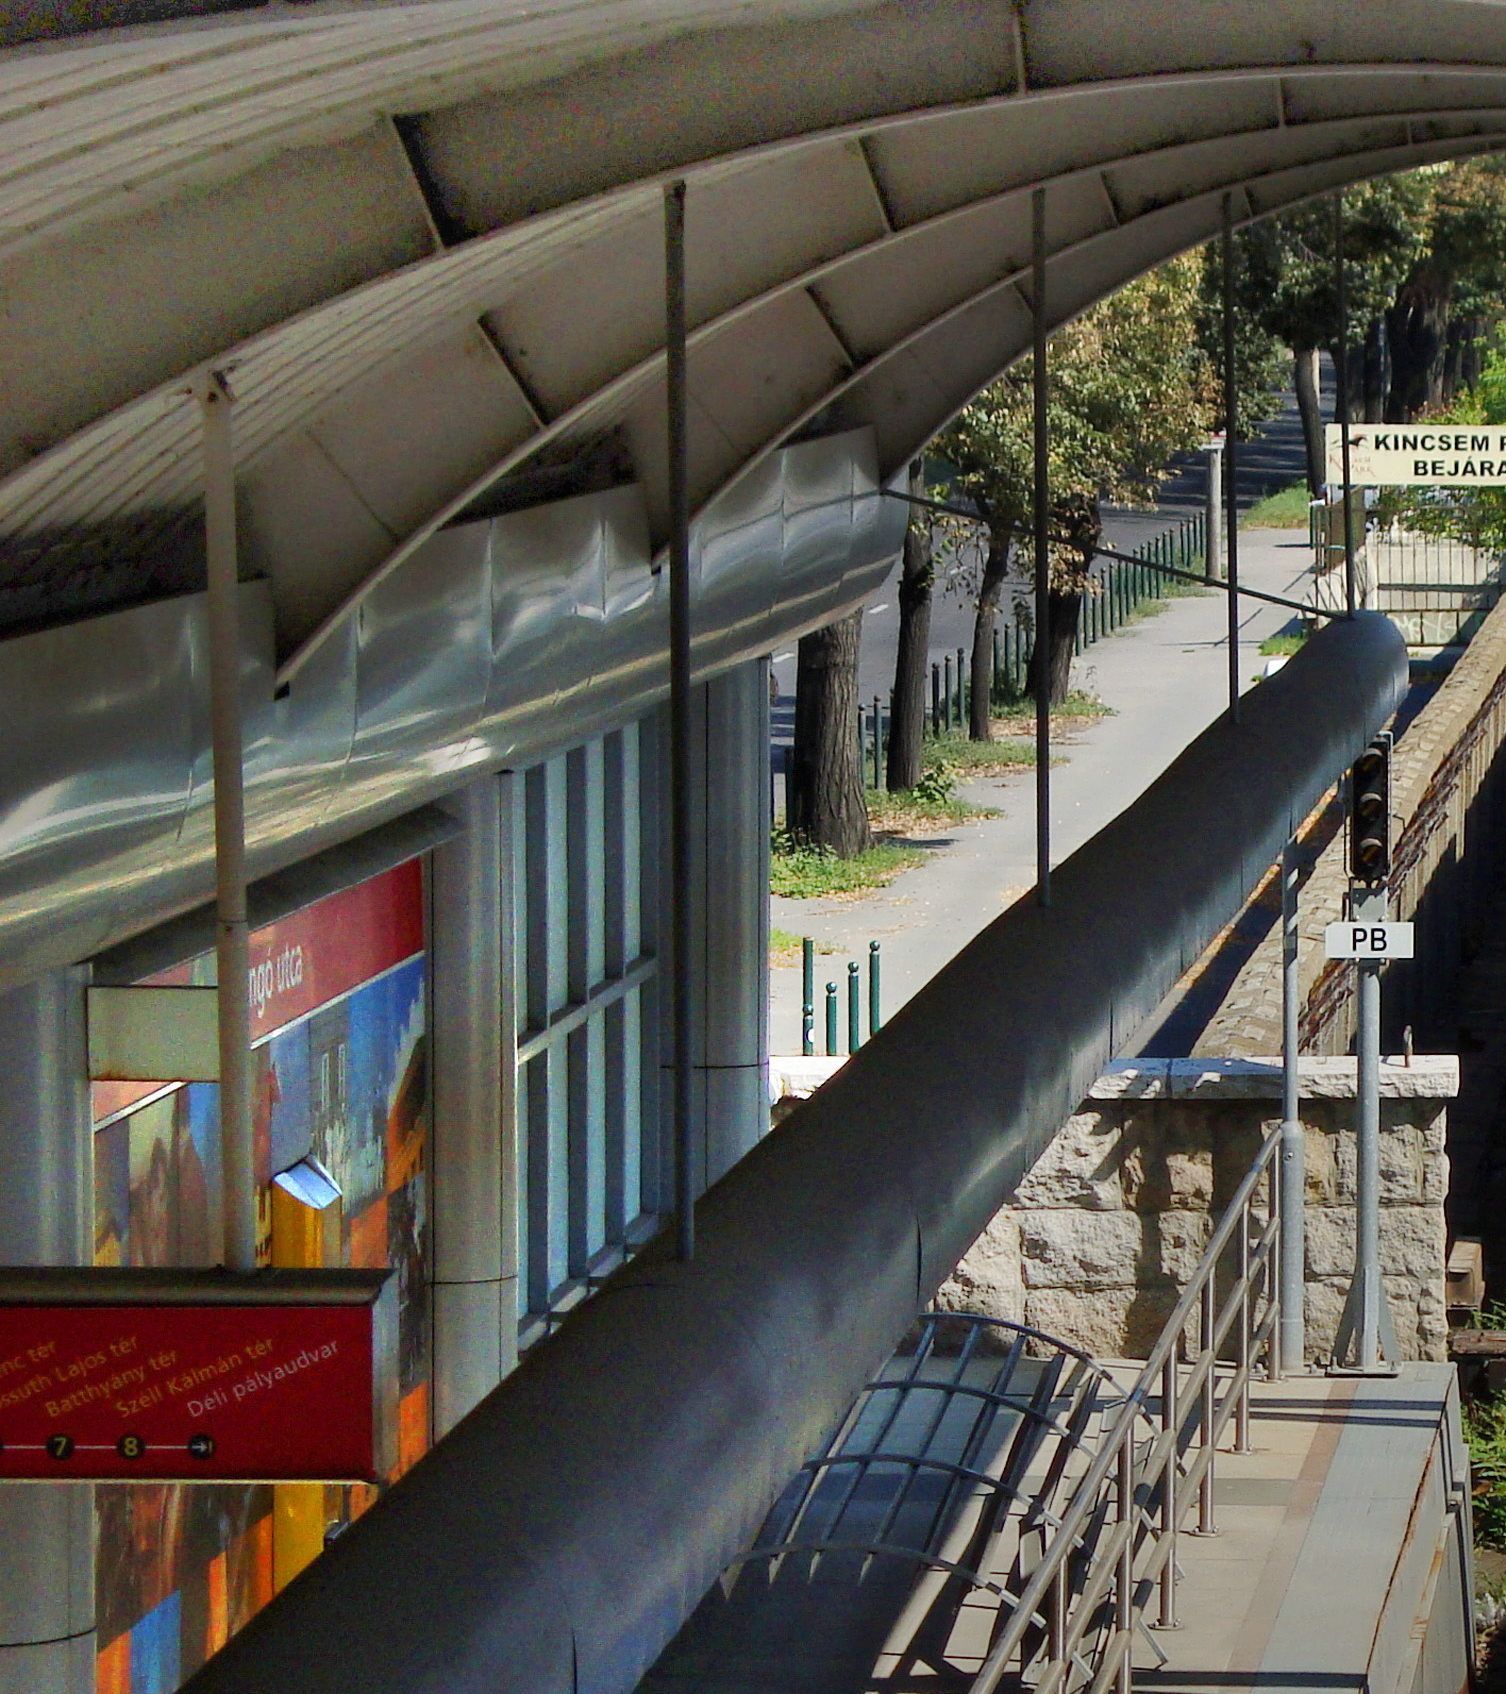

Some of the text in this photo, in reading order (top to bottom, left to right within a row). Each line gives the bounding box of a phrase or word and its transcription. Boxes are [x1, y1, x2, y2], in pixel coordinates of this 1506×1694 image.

[1374, 434, 1490, 452] KINCSEM
[1352, 927, 1388, 952] PB
[277, 942, 304, 993] utca
[55, 1351, 107, 1382] Lajos
[109, 1336, 137, 1357] tér
[115, 1339, 273, 1418] Széll Kálmán tér
[187, 1340, 339, 1418] Déli pályaudvar
[45, 1350, 177, 1417] Batthyány tér
[54, 1437, 138, 1456] 7 8
